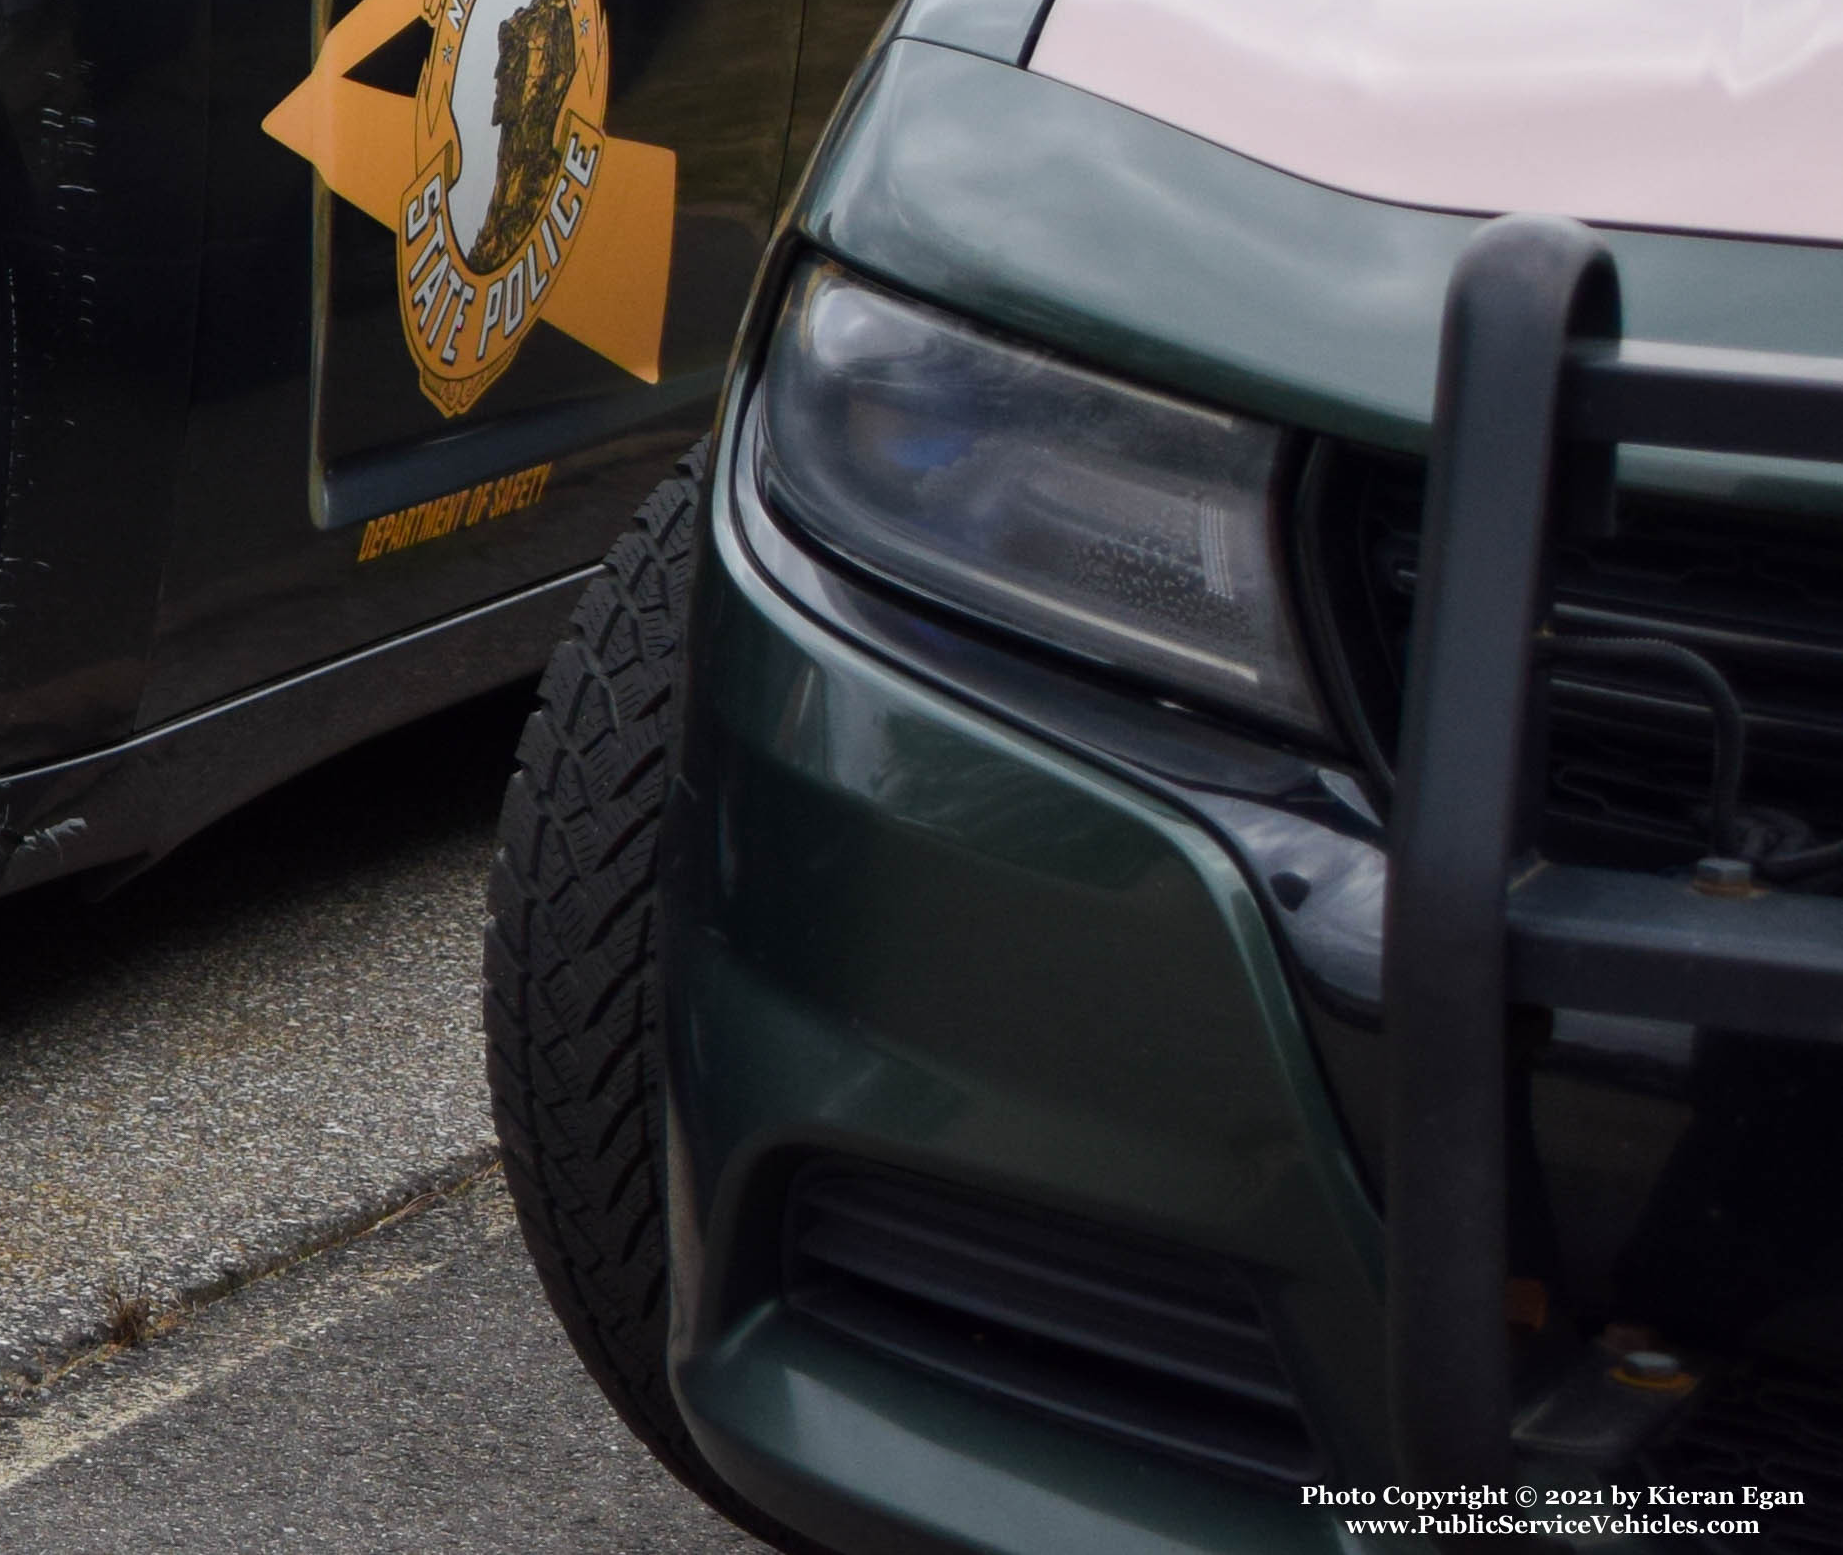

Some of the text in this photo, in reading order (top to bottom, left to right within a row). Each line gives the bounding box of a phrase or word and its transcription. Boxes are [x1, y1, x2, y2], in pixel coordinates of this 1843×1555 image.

[406, 134, 601, 366] STATE POLICE
[358, 461, 553, 562] DEPARTMENT OF SAFETY
